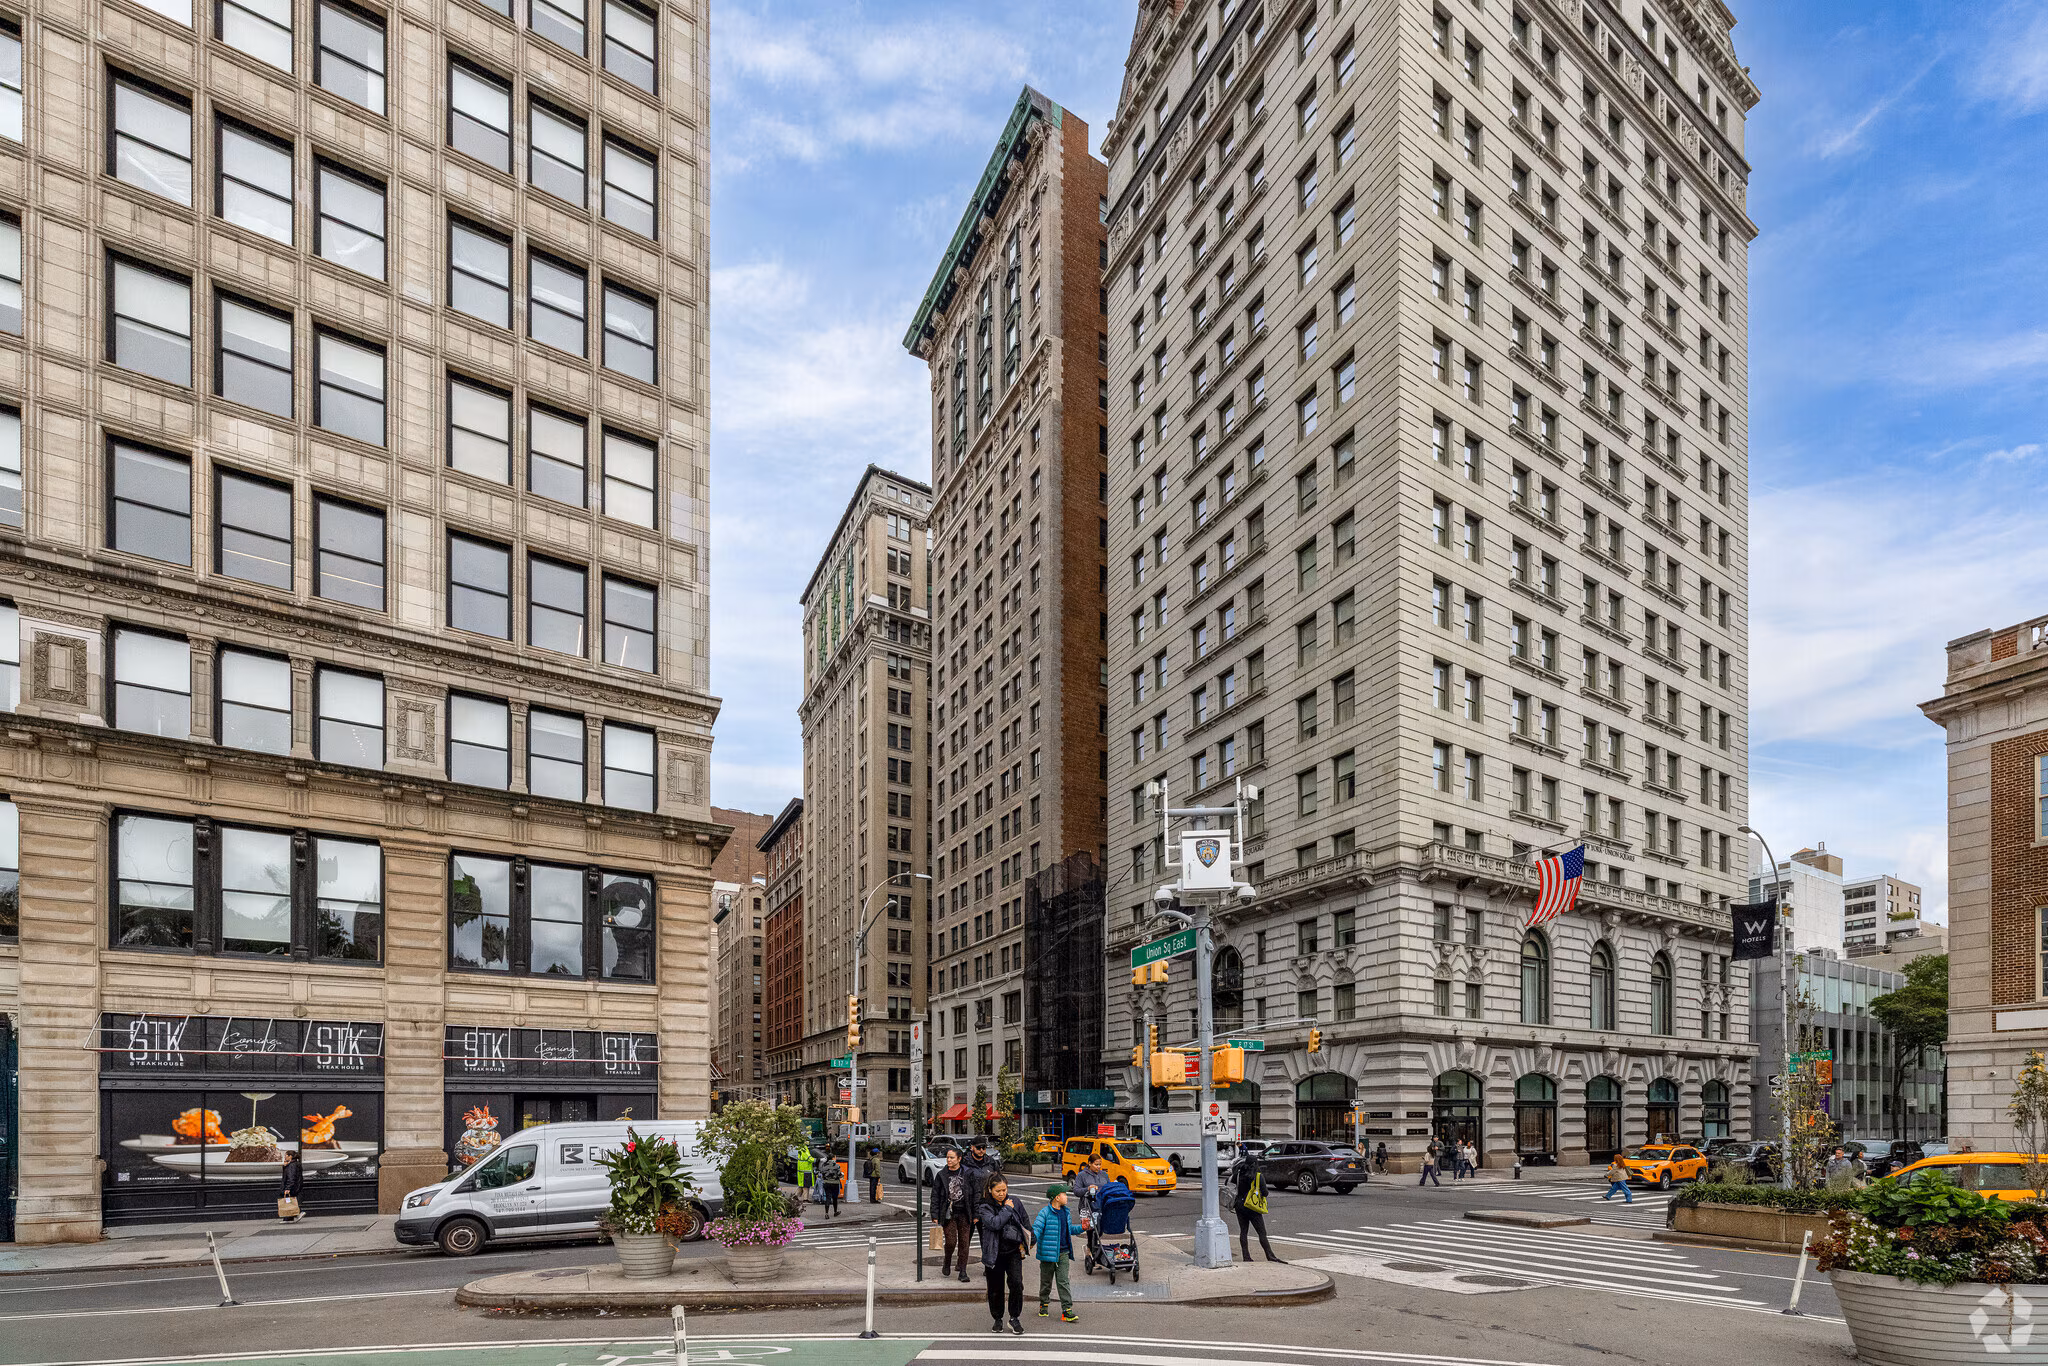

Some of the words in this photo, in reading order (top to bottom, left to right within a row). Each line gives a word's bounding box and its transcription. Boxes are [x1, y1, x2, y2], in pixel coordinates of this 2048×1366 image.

[1741, 935, 1767, 944] HOTELS
[1743, 919, 1768, 935] W
[1146, 945, 1162, 960] Union
[1163, 941, 1171, 955] Sq
[1172, 935, 1187, 951] East
[130, 1020, 185, 1061] STK
[223, 1032, 282, 1052] Coming
[317, 1026, 365, 1065] STK
[464, 1032, 506, 1068] STK
[534, 1042, 579, 1059] Coming
[605, 1037, 641, 1071] STK
